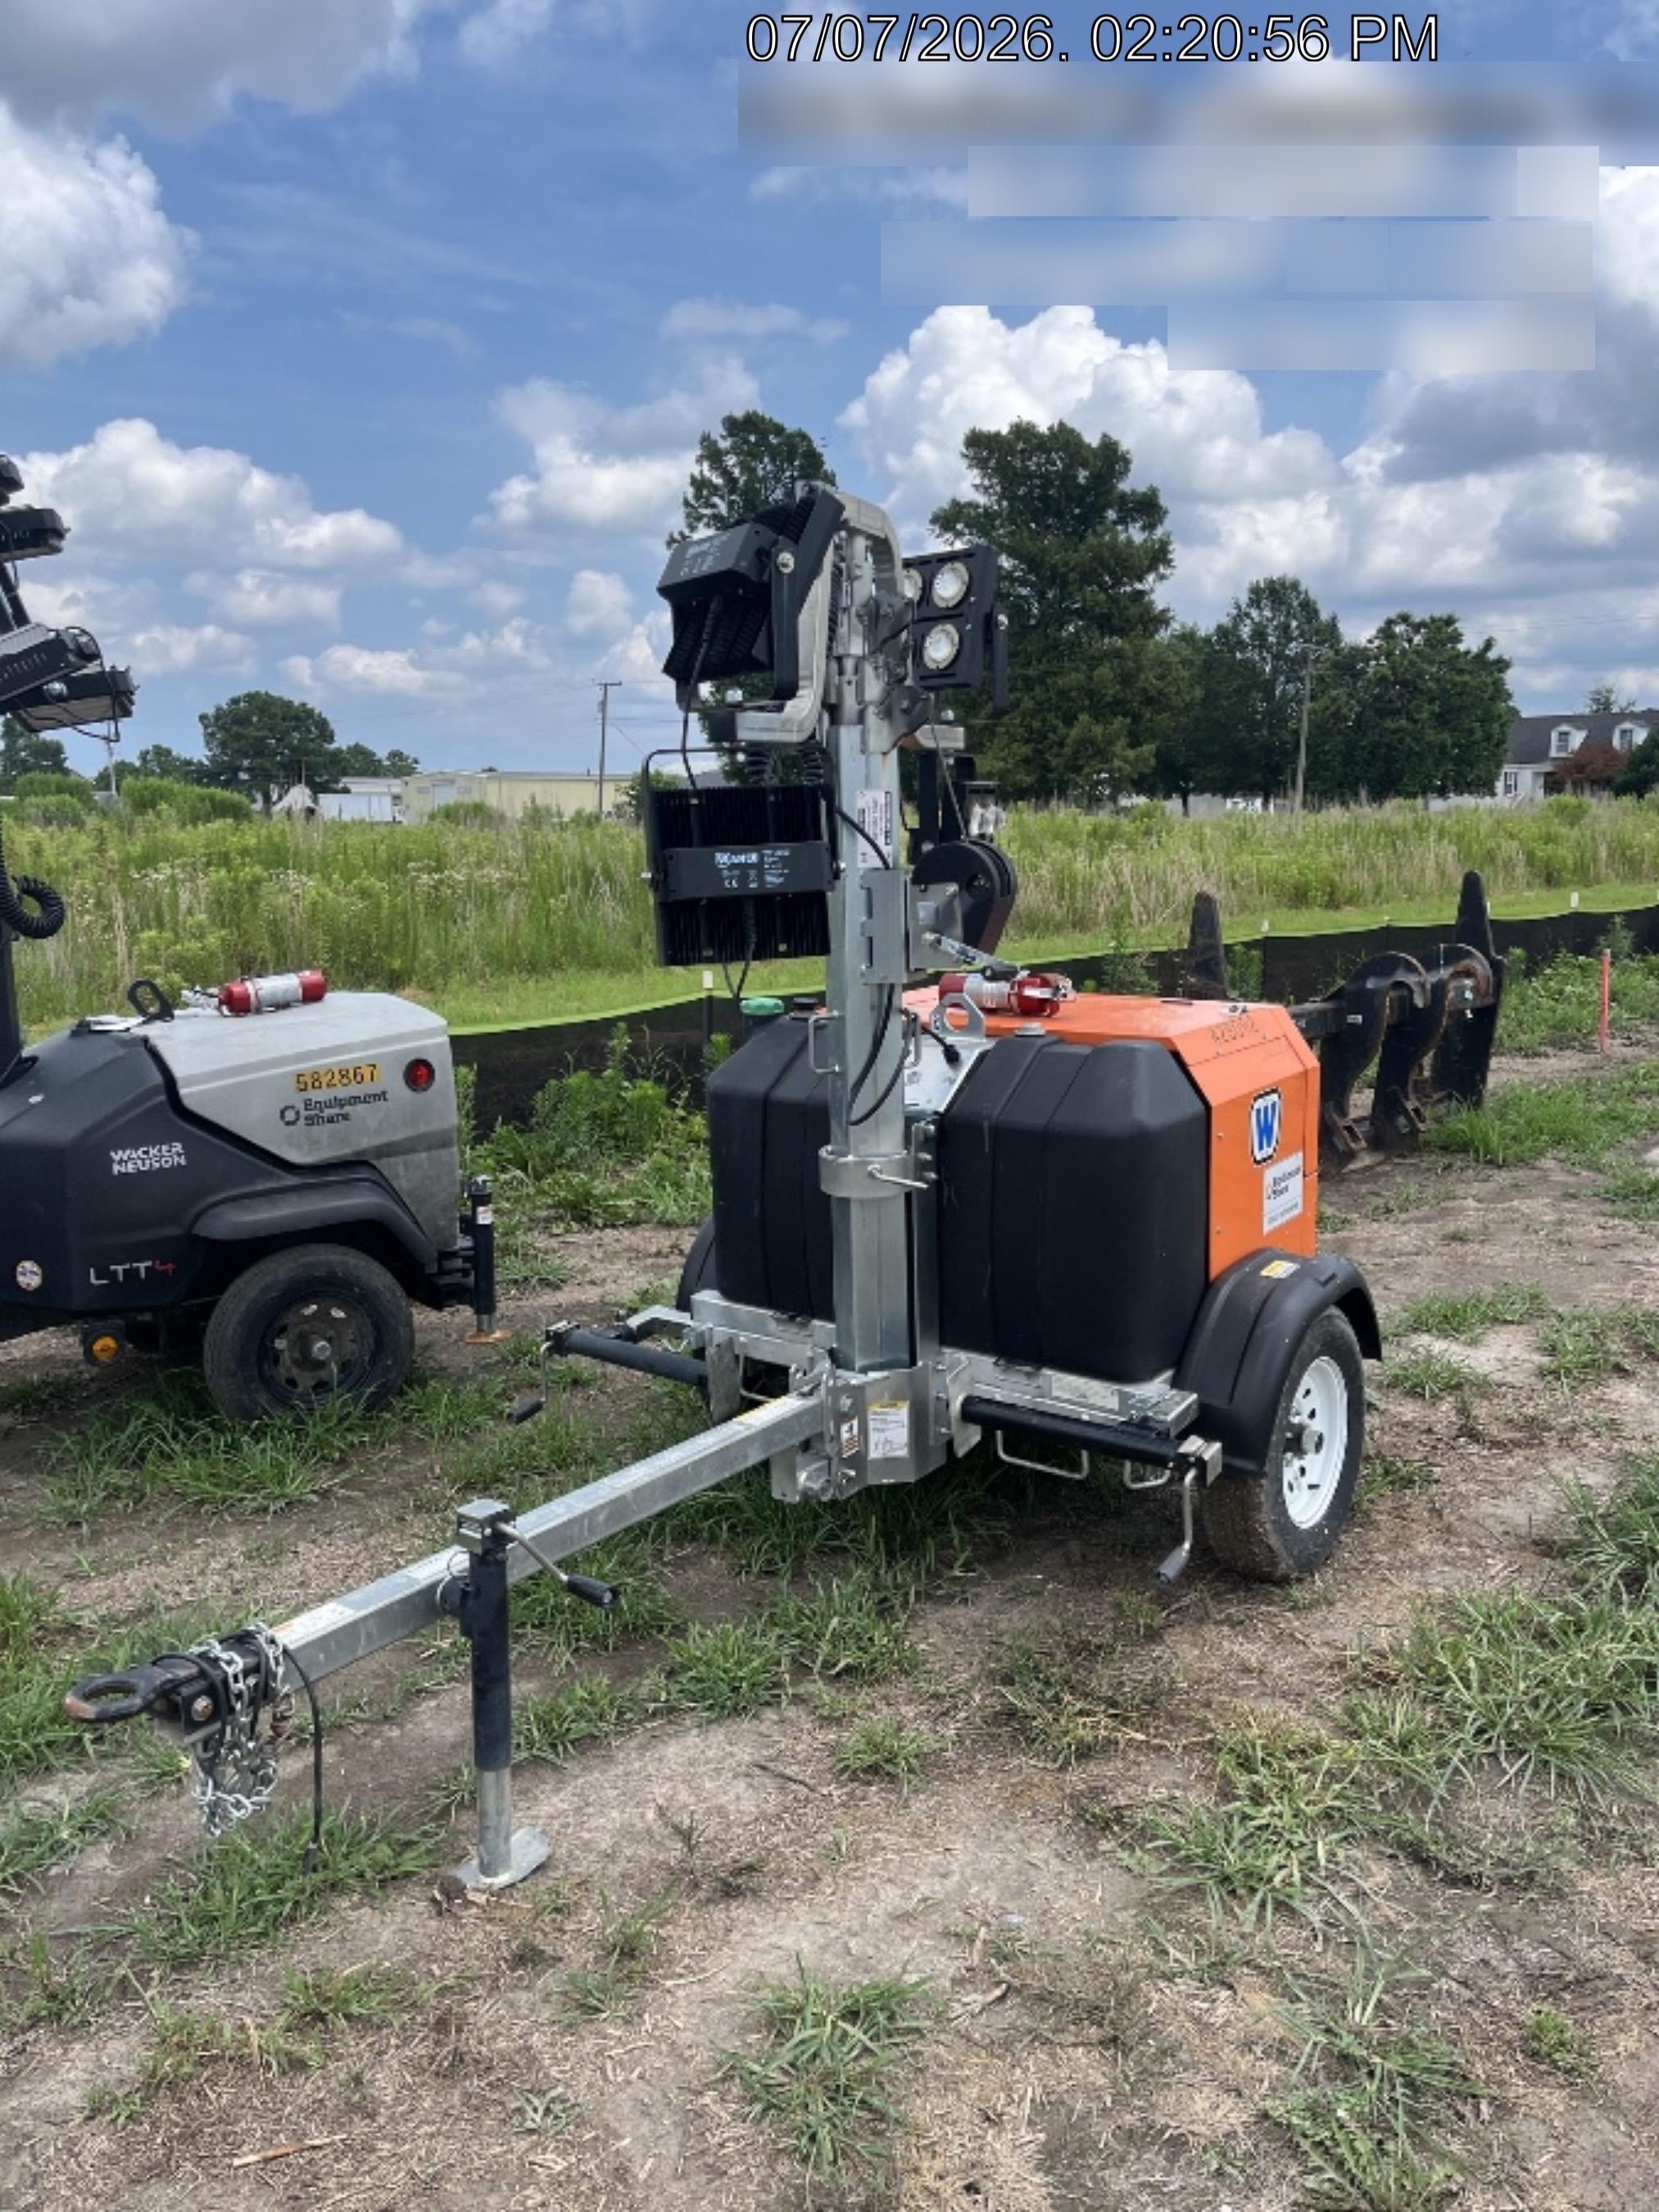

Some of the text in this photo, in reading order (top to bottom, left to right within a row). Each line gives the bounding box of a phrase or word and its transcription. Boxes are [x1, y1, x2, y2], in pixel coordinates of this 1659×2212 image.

[296, 1063, 377, 1091] 582867
[303, 1090, 389, 1113] Equipment
[303, 1112, 351, 1126] Share
[1256, 1100, 1276, 1153] W
[110, 1142, 184, 1161] WACKER
[112, 1155, 187, 1175] NEUSON
[89, 1259, 176, 1286] LTT4
